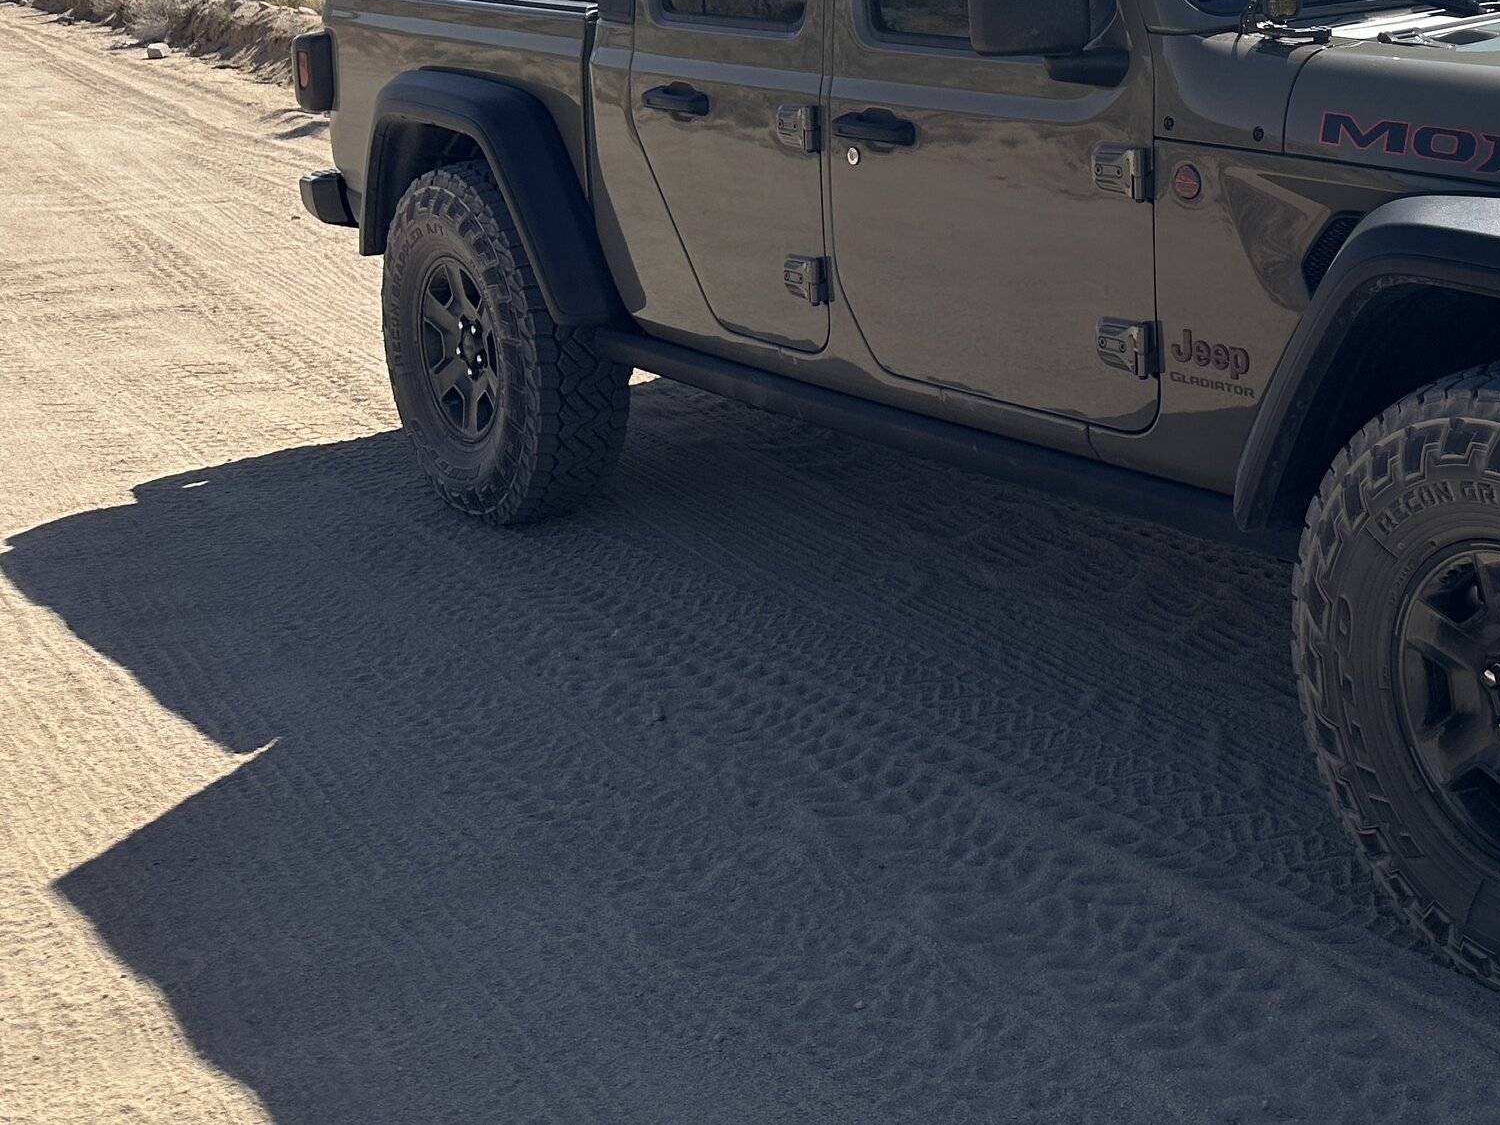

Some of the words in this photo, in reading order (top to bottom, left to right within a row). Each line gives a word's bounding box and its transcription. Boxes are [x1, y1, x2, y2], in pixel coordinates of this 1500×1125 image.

[1170, 328, 1251, 380] Jeep
[1169, 371, 1256, 399] GLADIATOR
[1376, 481, 1456, 537] RECON
